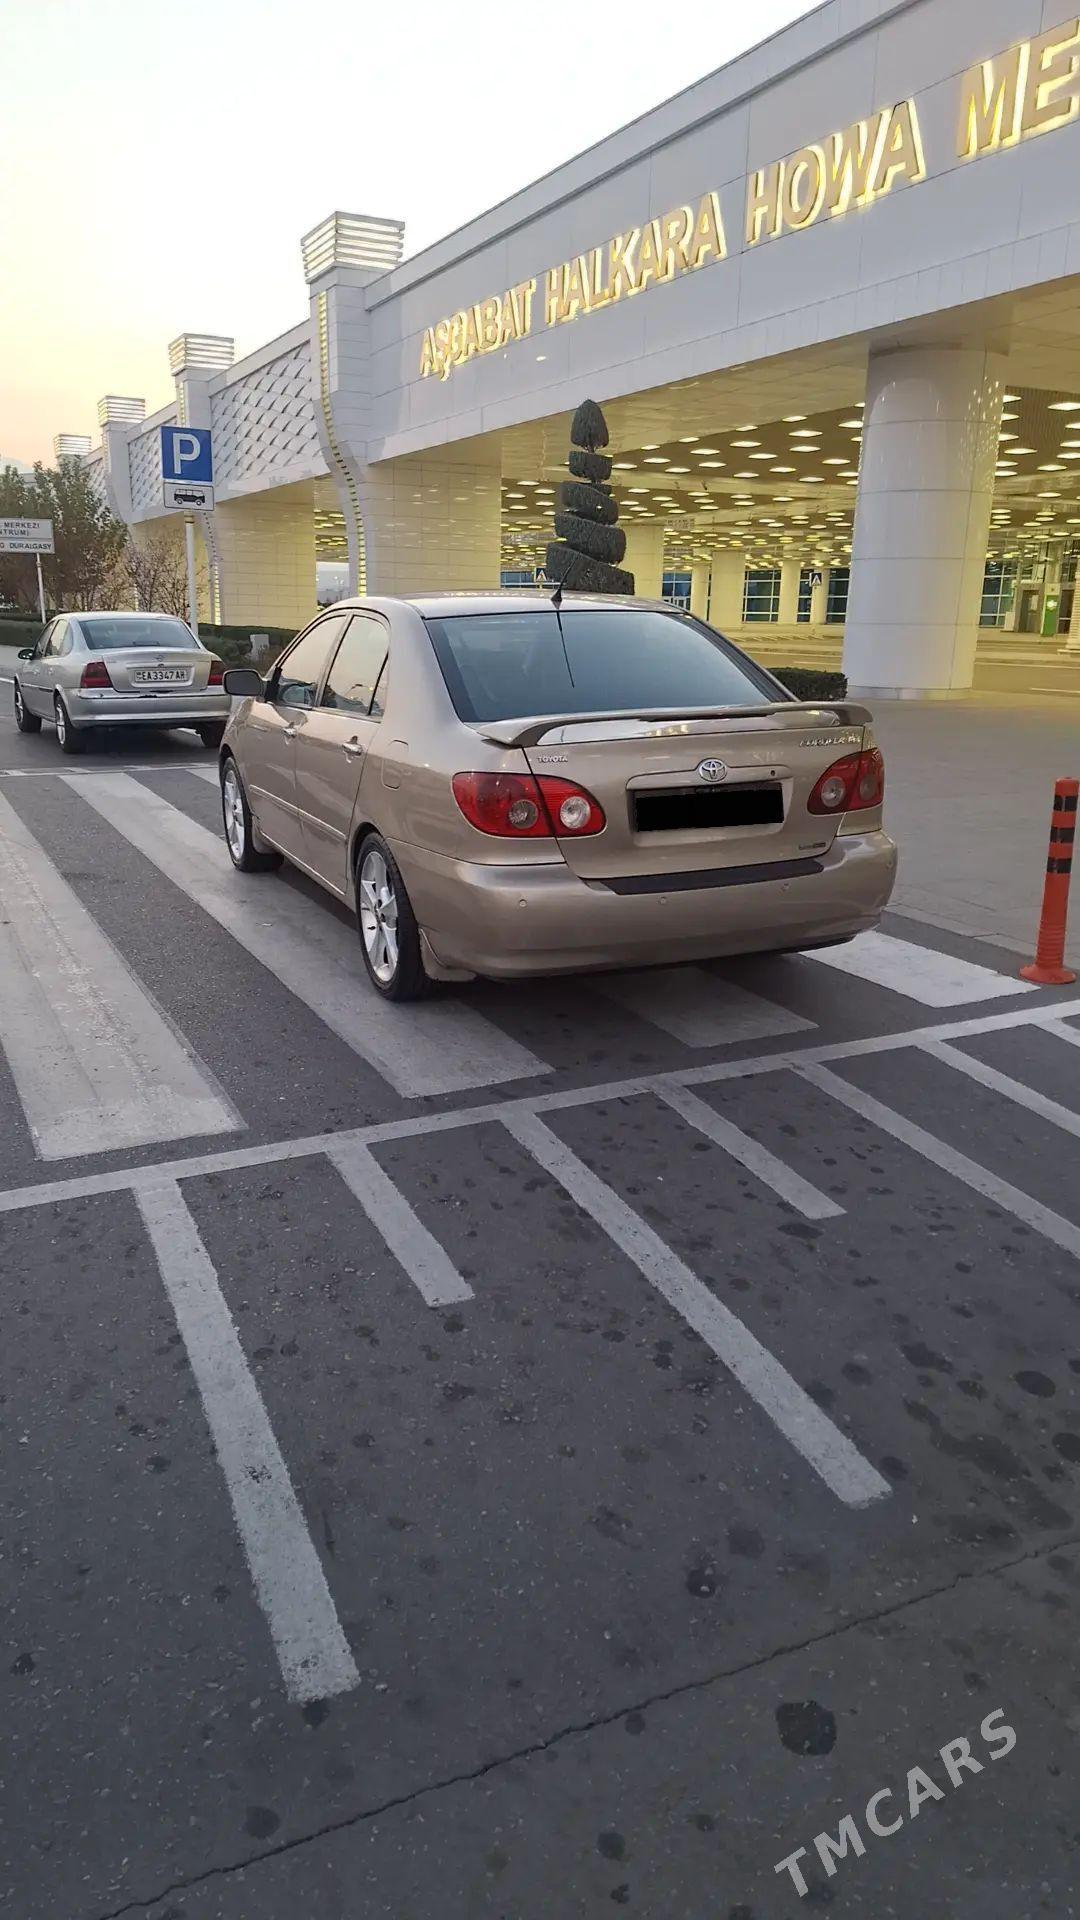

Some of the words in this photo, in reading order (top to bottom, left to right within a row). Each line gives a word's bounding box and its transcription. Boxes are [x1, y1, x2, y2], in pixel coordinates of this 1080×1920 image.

[544, 191, 727, 325] HALKARA
[745, 97, 926, 243] HOWA
[172, 432, 201, 475] P
[9, 542, 52, 550] DURALGASY
[536, 755, 568, 763] TOYOTA
